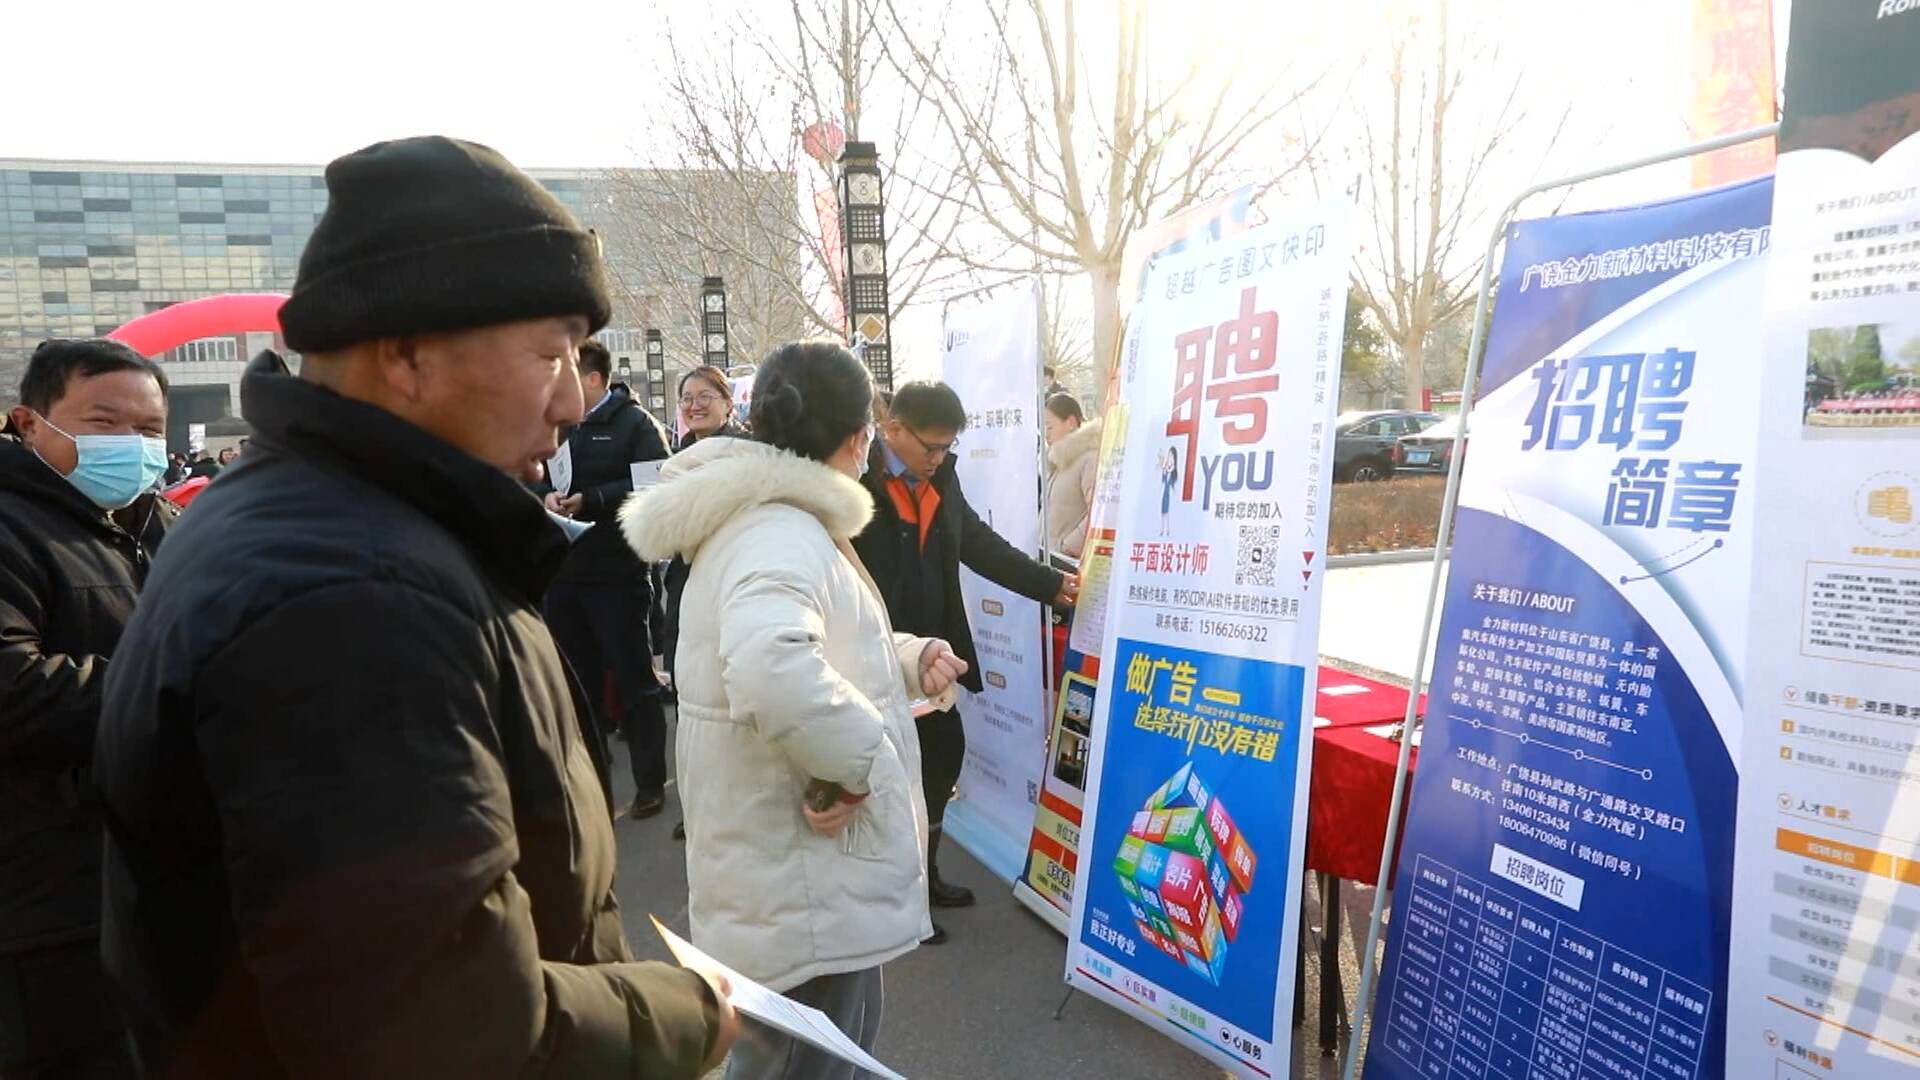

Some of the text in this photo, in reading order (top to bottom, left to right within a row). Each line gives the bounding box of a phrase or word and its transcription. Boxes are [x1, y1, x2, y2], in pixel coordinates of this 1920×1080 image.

[1166, 286, 1280, 502] 聘
[1521, 347, 1697, 452] 招聘
[1201, 451, 1275, 511] YOU
[1602, 457, 1742, 533] 简章
[1214, 502, 1283, 520] 期待您的加入
[1129, 543, 1210, 576] 平面设计师
[1472, 584, 1575, 613] 关于我们/ABOUT
[1125, 652, 1198, 706] 做广告
[1134, 701, 1280, 763] 选择我们没有错
[1505, 856, 1566, 899] 招聘岗位
